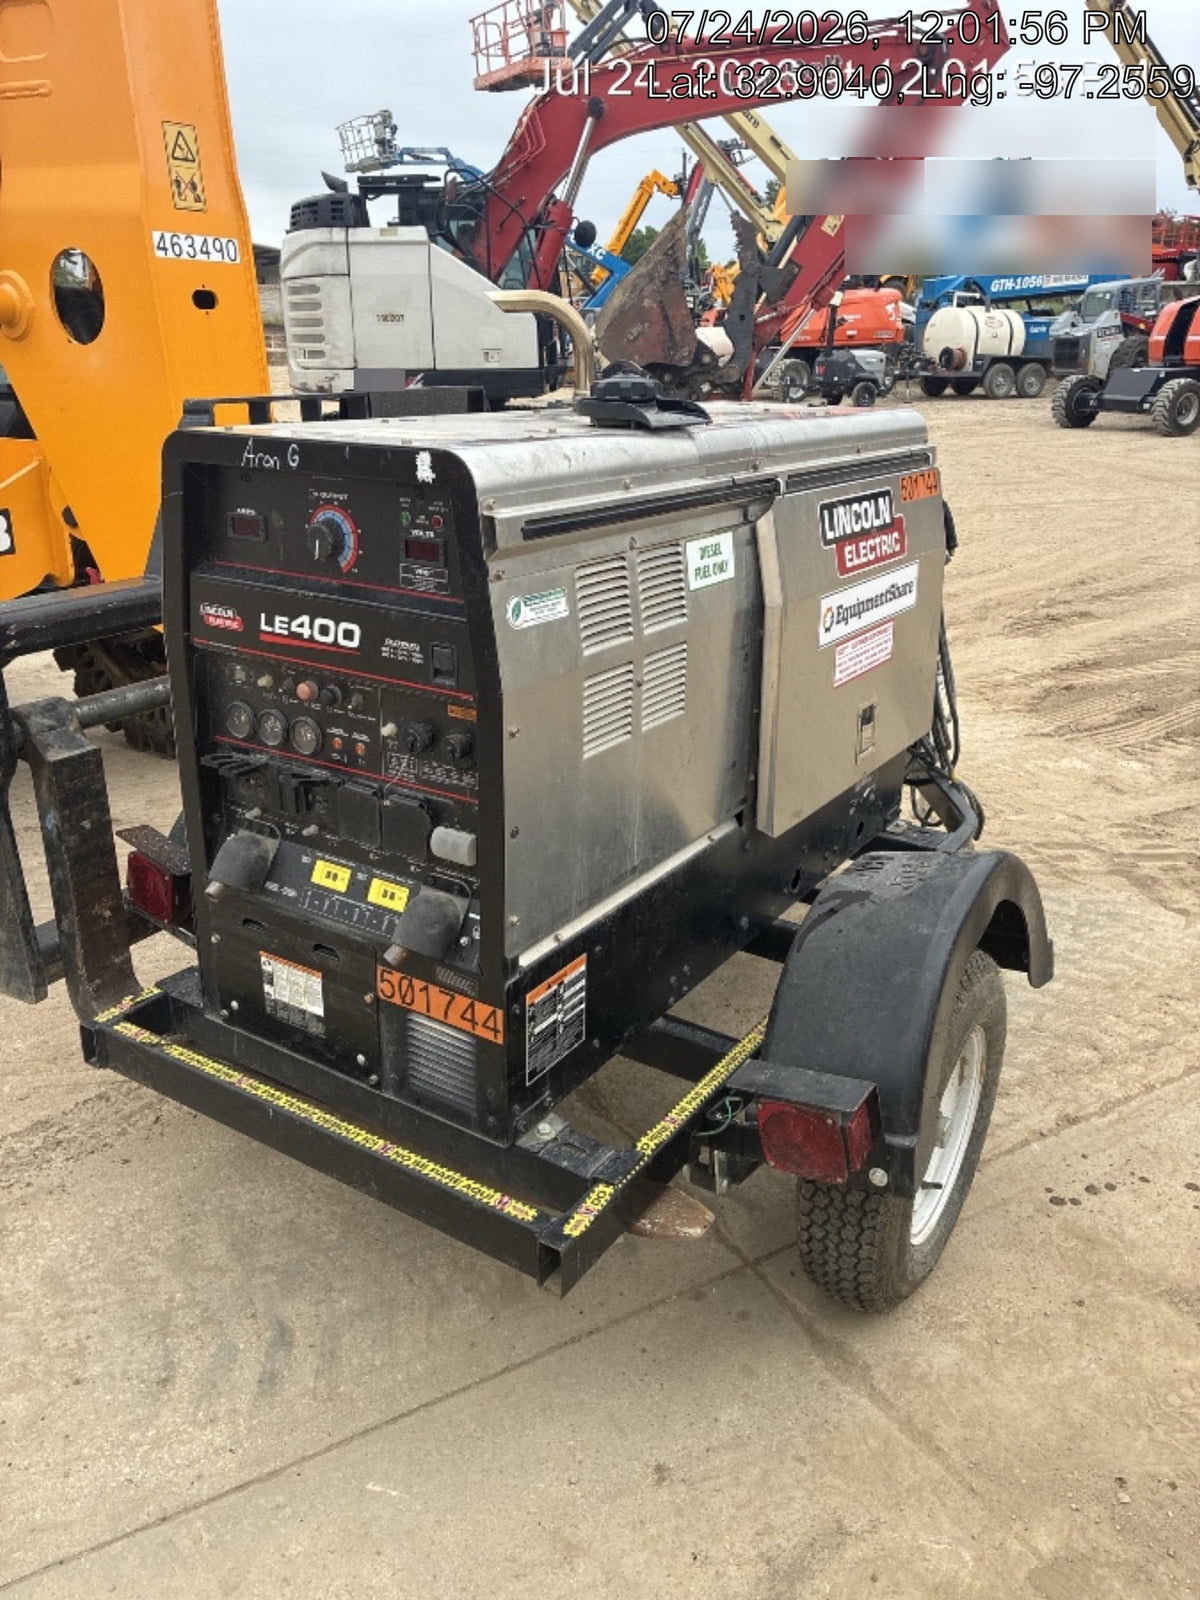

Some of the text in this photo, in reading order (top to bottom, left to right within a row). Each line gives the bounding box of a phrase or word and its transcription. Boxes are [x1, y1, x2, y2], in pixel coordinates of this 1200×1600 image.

[155, 232, 238, 262] 463490
[286, 443, 300, 467] G
[900, 473, 939, 500] 501744
[822, 496, 892, 540] LINCOLN
[699, 541, 722, 561] DIESEL
[844, 531, 901, 568] ELECTRIC
[694, 564, 713, 582] FUEL
[835, 580, 915, 625] EquipmentShare
[259, 611, 361, 649] LE400
[378, 970, 501, 1038] 501744
